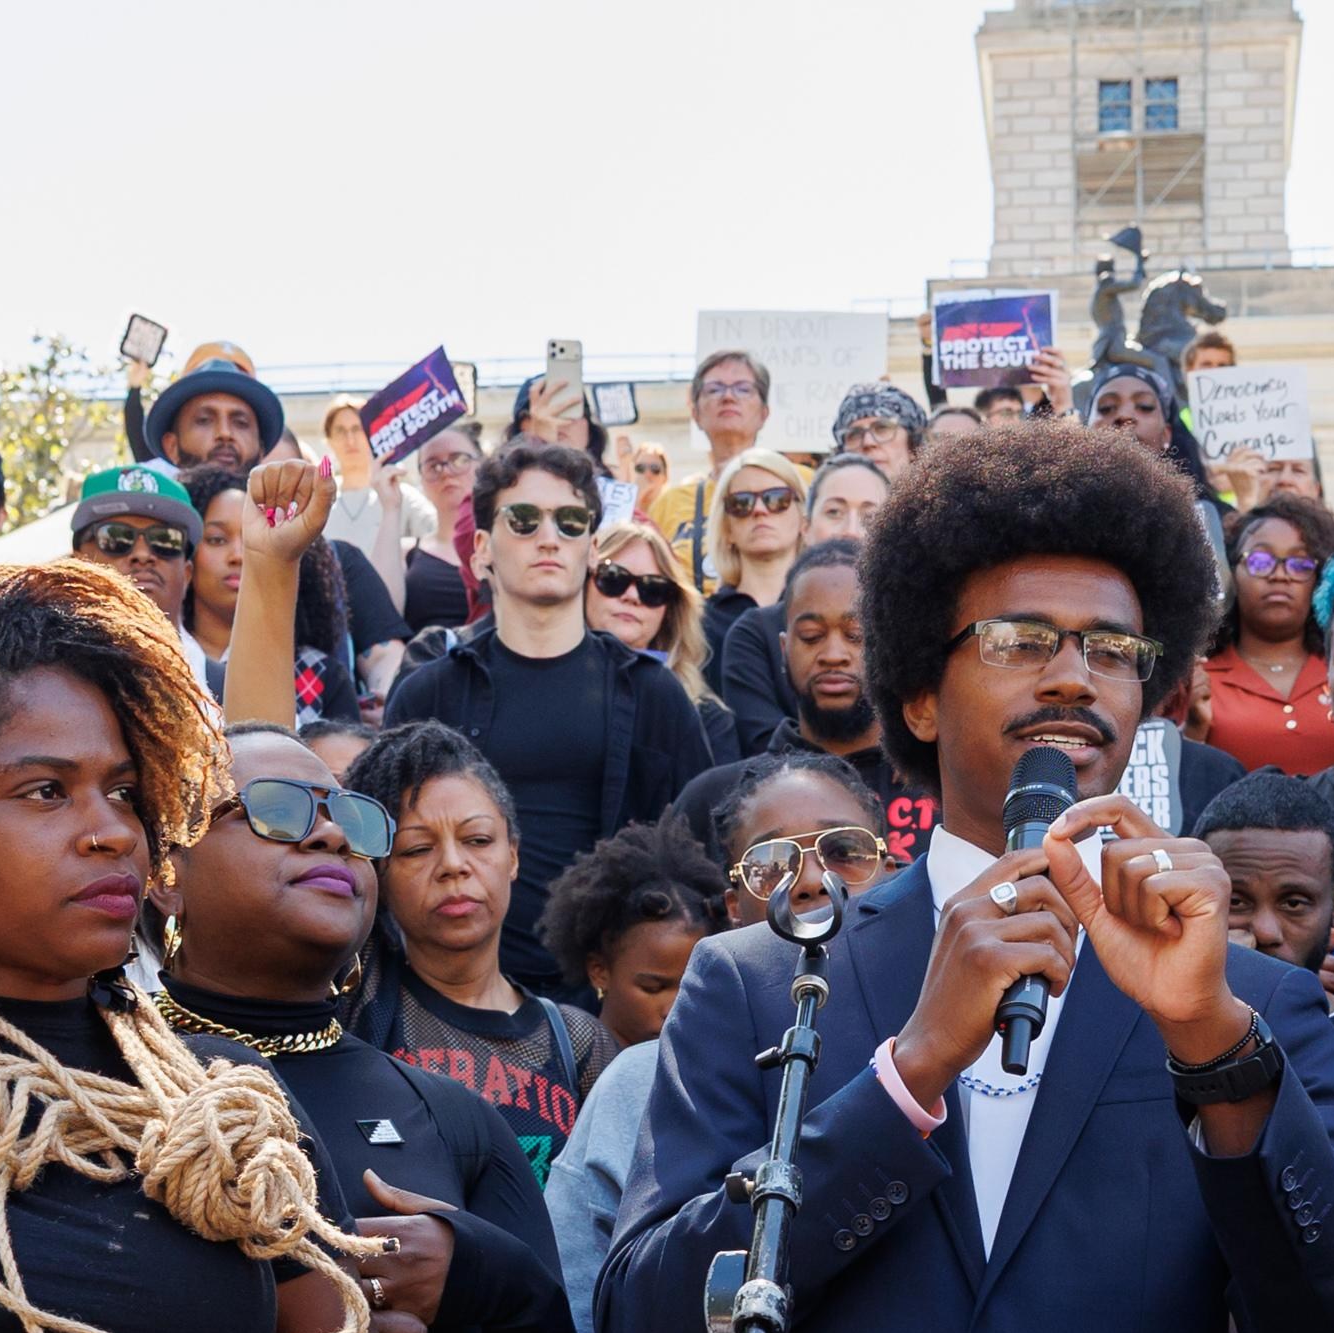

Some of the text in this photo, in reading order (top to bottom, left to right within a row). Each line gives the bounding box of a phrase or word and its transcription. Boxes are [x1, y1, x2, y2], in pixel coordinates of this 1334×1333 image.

[940, 336, 1029, 354] PROTECT
[940, 353, 979, 370] THE
[370, 389, 439, 448] PROTECT
[374, 431, 406, 457] THE
[1129, 729, 1166, 766] CK
[1117, 765, 1169, 797] ERS
[393, 1047, 578, 1136] ERATIO
